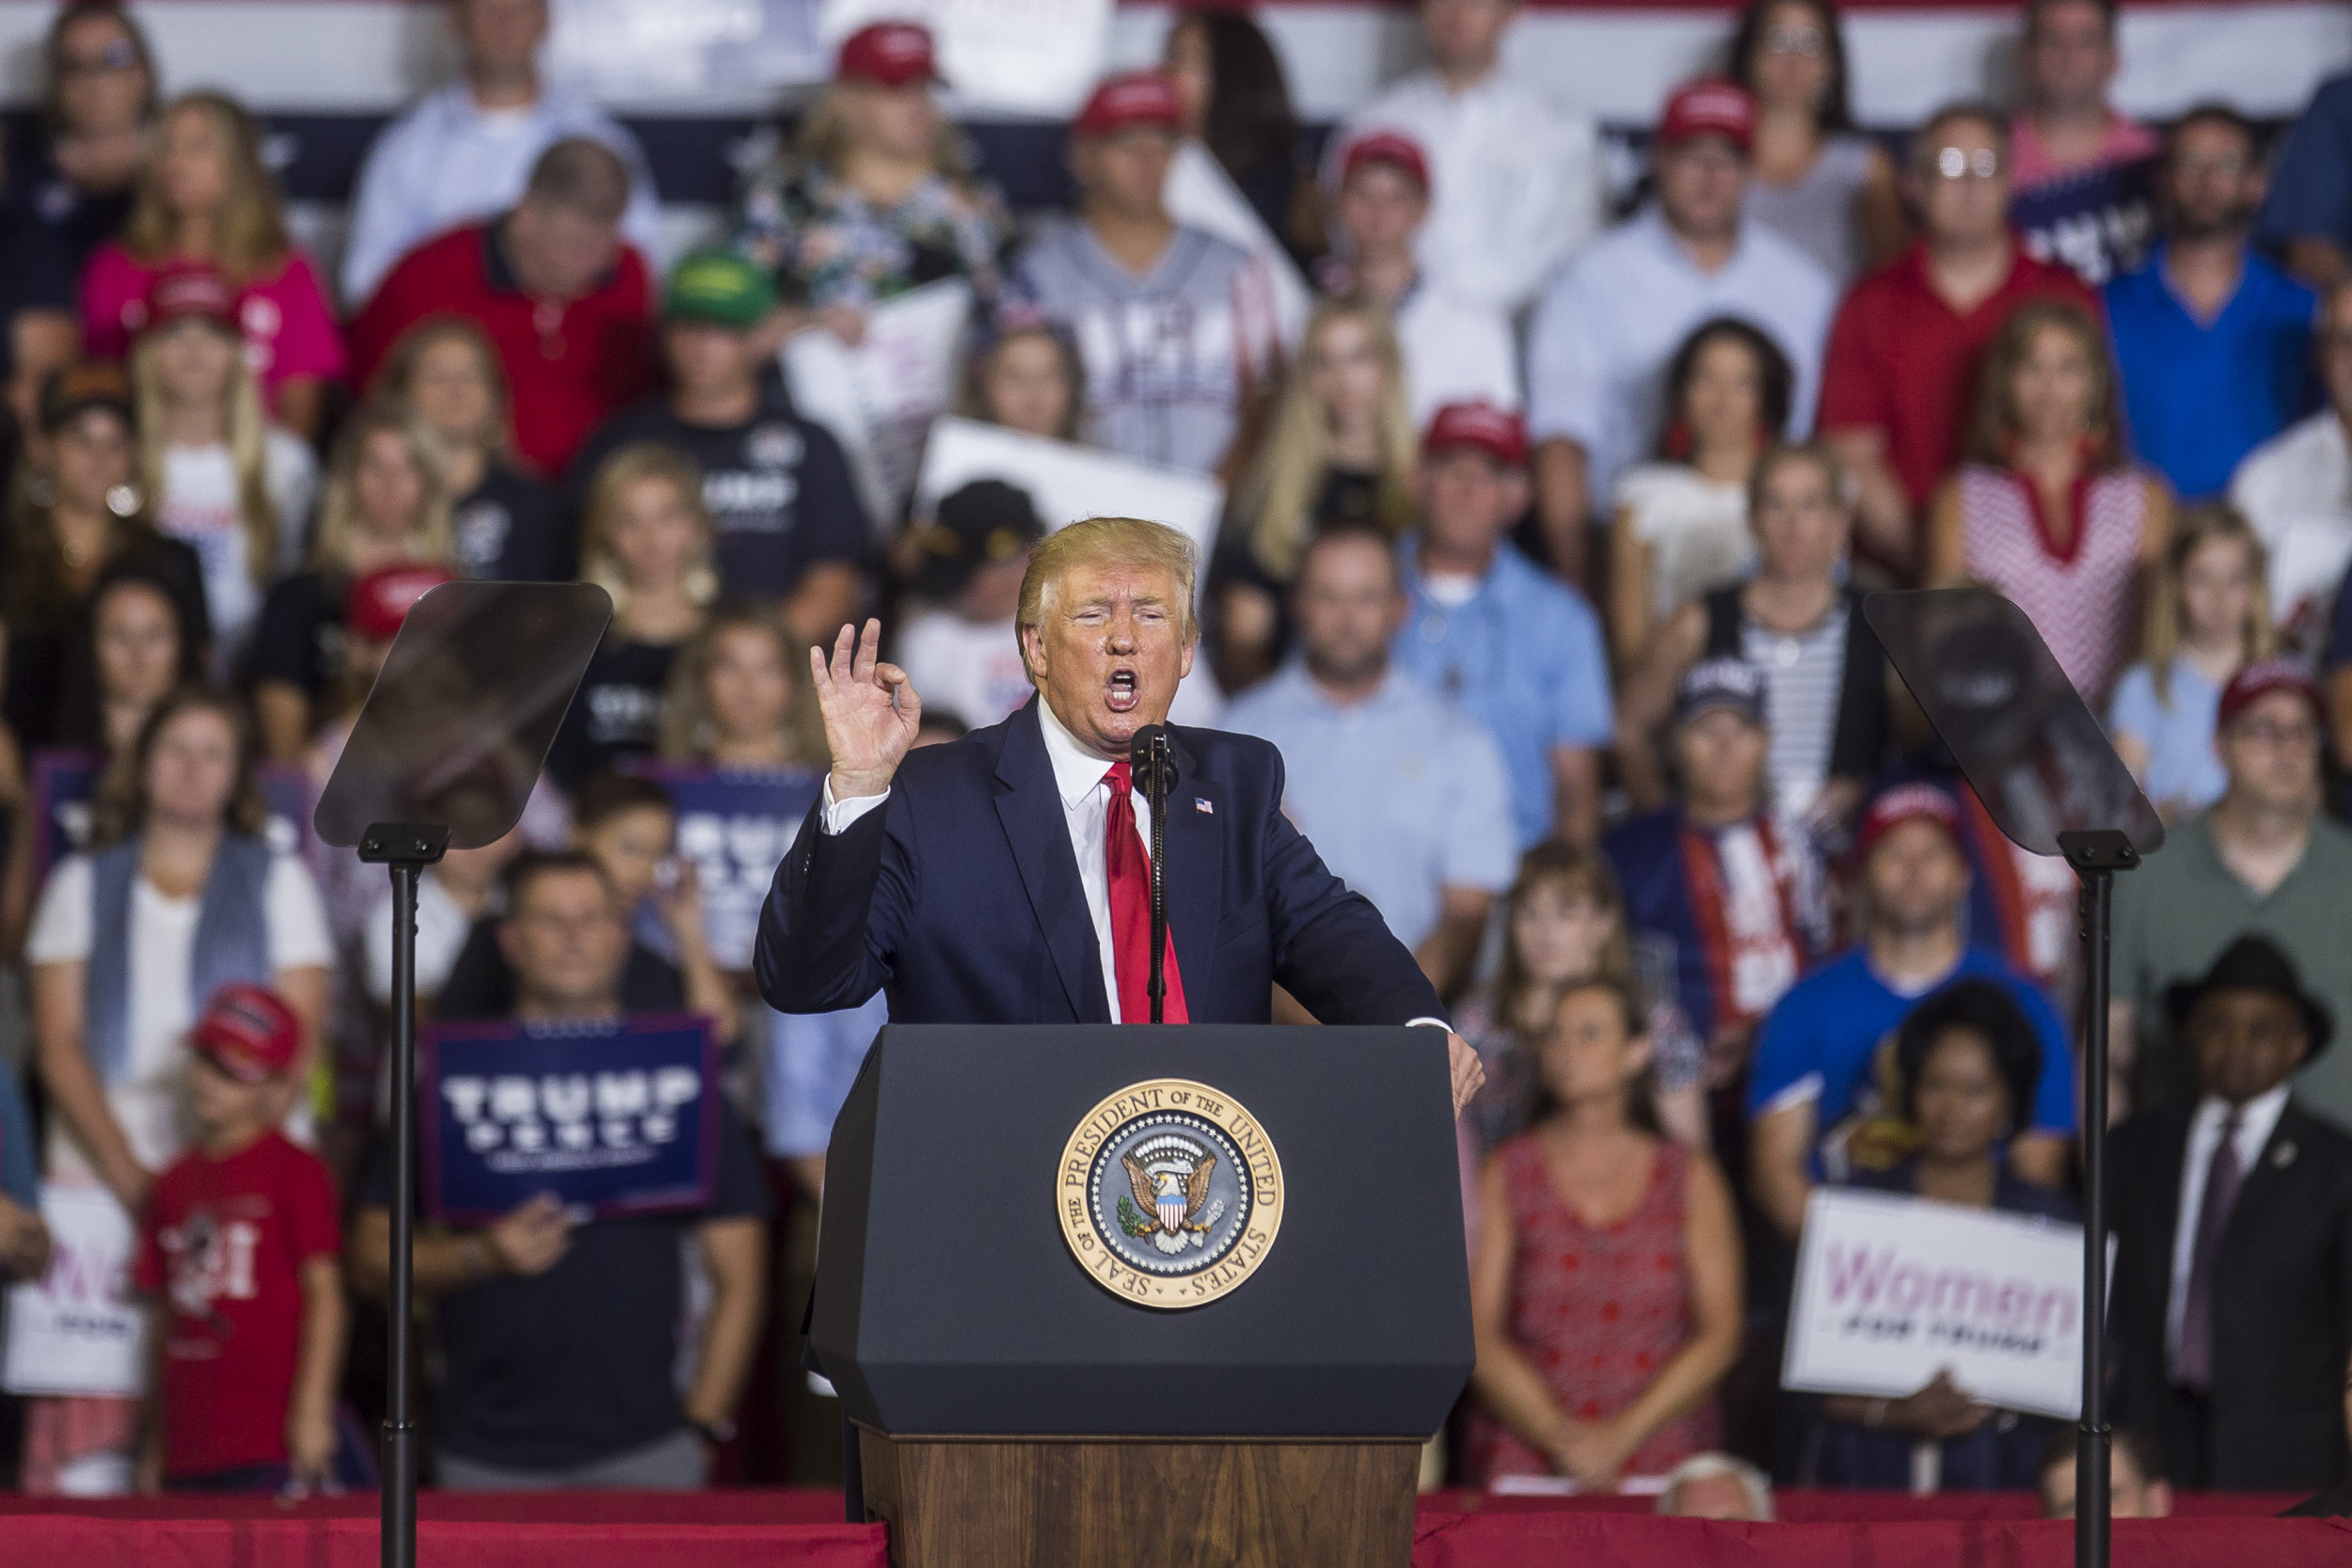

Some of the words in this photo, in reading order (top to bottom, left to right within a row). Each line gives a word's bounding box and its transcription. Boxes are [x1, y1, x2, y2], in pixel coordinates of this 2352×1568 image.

[440, 1066, 700, 1127] TRUMP
[1170, 1091, 1191, 1105] OF
[1196, 1095, 1224, 1117] THE
[466, 1113, 678, 1153] PENCE
[1066, 1089, 1163, 1189] PRESIDENT
[1230, 1115, 1276, 1206] UNITED
[1068, 1196, 1086, 1228] THE
[1077, 1232, 1095, 1252] OF
[1192, 1227, 1266, 1296] STATES
[1095, 1249, 1152, 1296] SEAL
[1823, 1241, 2078, 1339] Women
[1841, 1314, 1915, 1342] FOR
[1927, 1318, 2044, 1357] TRUMP
